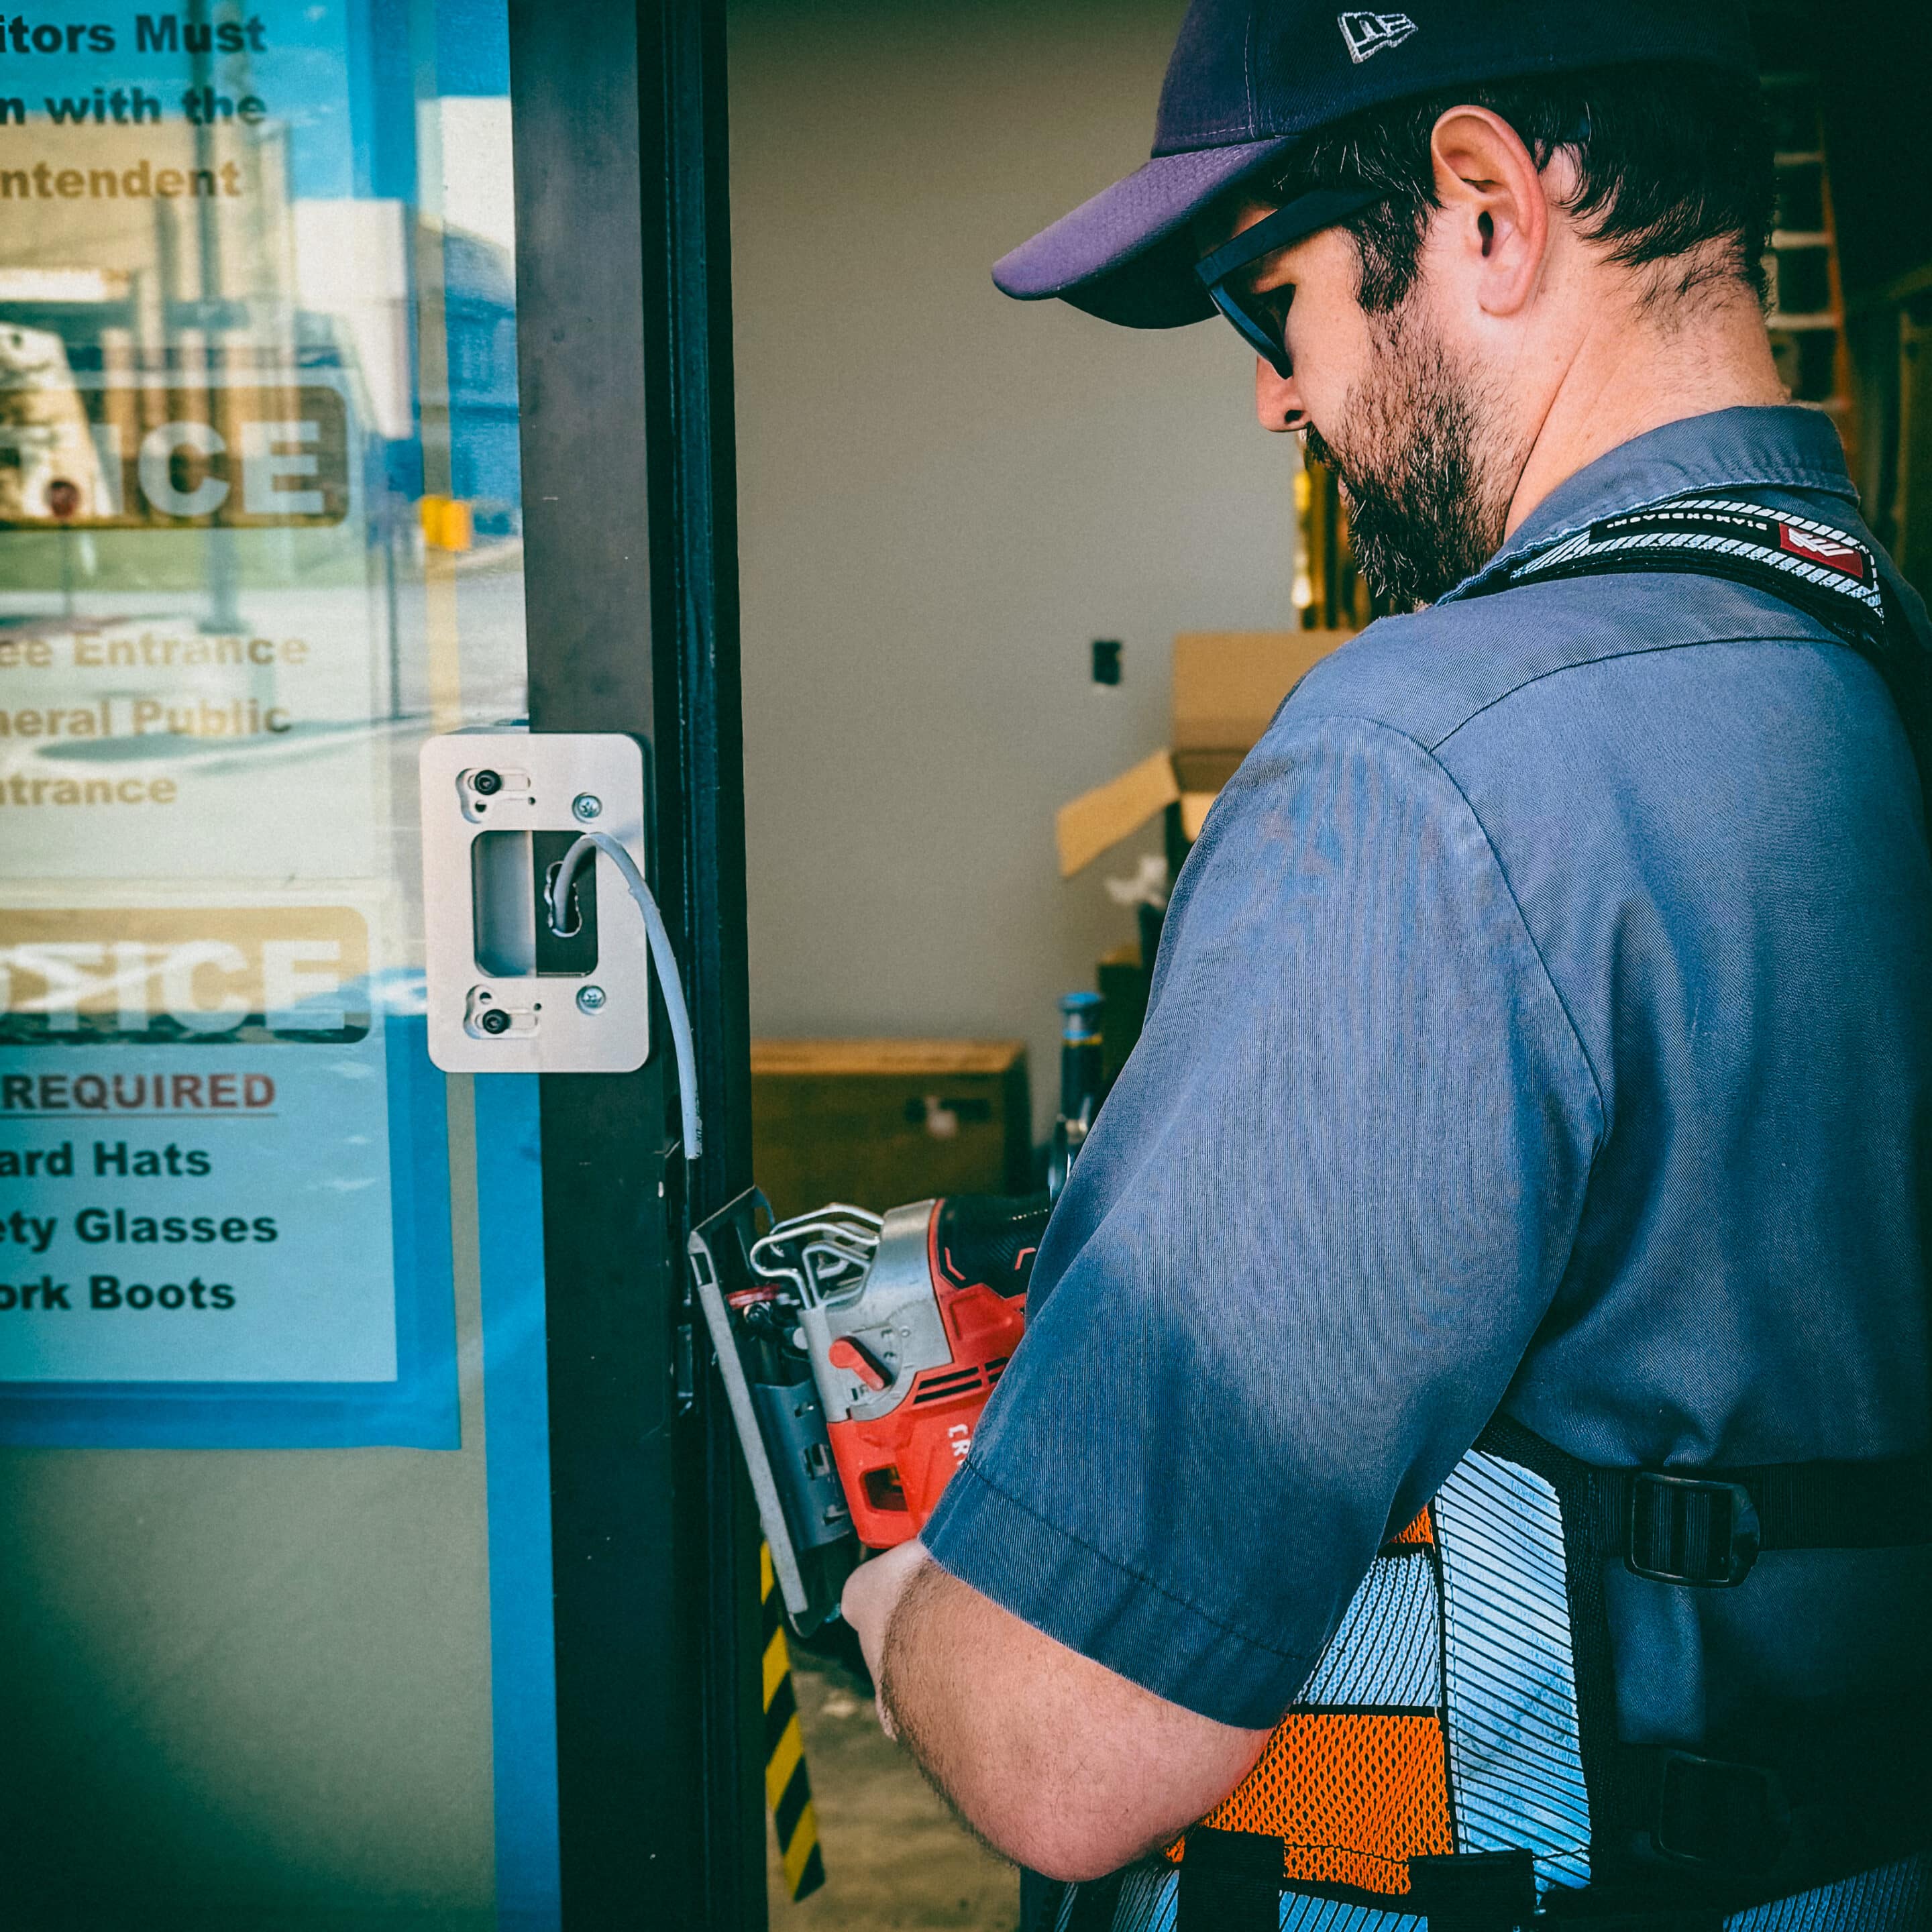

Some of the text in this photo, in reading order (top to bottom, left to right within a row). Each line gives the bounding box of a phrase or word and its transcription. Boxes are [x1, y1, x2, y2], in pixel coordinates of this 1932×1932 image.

[136, 14, 266, 53] Must
[45, 88, 162, 125] with
[182, 87, 267, 125] the
[1, 160, 241, 199] ntendent
[0, 631, 310, 667] ee Entrance
[134, 699, 291, 736] Public
[0, 772, 177, 805] trance
[2, 1075, 276, 1110] REQUIRED
[0, 1141, 211, 1177] ard Hats
[0, 1208, 278, 1254] ty Glasses
[0, 1275, 236, 1311] ork Boots
[948, 1424, 971, 1466] CR
